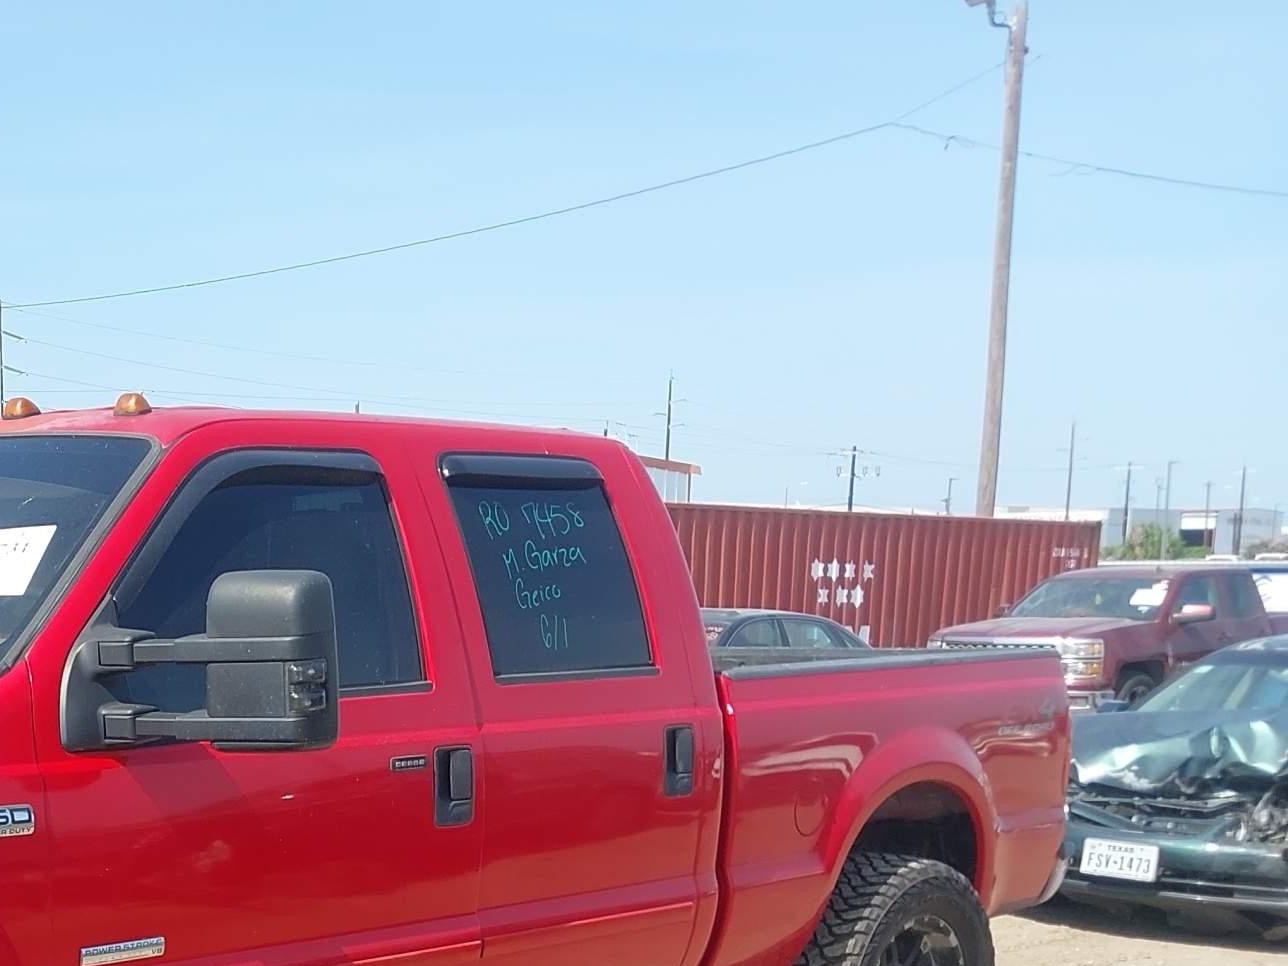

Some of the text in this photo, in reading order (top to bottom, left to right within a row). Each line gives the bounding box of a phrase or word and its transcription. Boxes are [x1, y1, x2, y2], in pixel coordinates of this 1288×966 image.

[478, 500, 585, 540] RO 7458
[524, 539, 588, 573] Garza
[515, 577, 562, 609] Geico
[540, 613, 569, 651] 6/1
[8, 826, 32, 836] DUTY
[1107, 844, 1134, 853] TEXAS
[85, 945, 122, 957] POWER
[123, 938, 163, 951] STROKE
